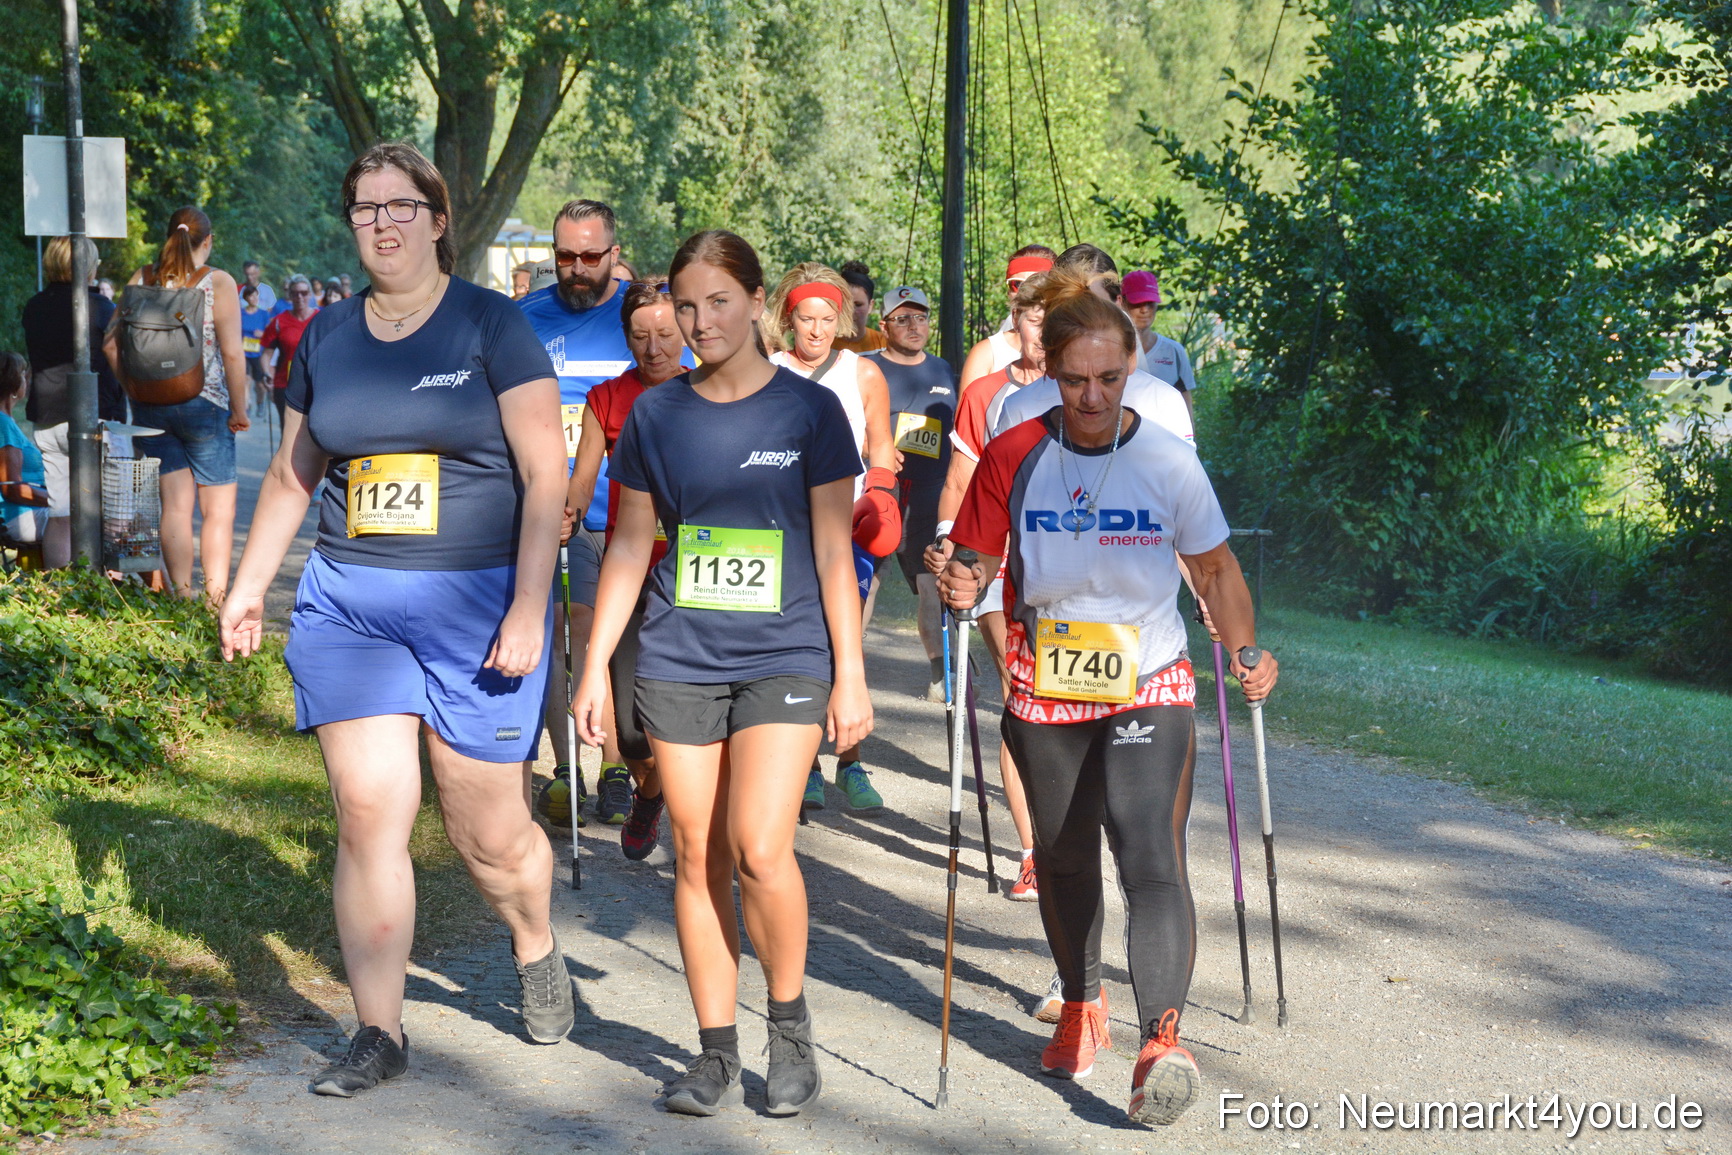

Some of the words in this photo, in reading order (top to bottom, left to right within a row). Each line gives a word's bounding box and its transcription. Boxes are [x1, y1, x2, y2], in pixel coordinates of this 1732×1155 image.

[411, 373, 457, 391] JURA
[740, 451, 787, 468] JURA
[355, 482, 424, 512] 1124
[357, 512, 384, 521] Cvijovic
[386, 511, 415, 520] Bojana
[1099, 530, 1162, 546] energie
[689, 555, 766, 587] 1132
[693, 585, 718, 594] Reindl
[719, 587, 758, 596] Christina
[1048, 648, 1123, 680] 1740
[1058, 677, 1082, 686] Sattler
[1083, 680, 1109, 689] Nicole
[1051, 702, 1111, 721] AVIA
[1112, 736, 1152, 745] adidas
